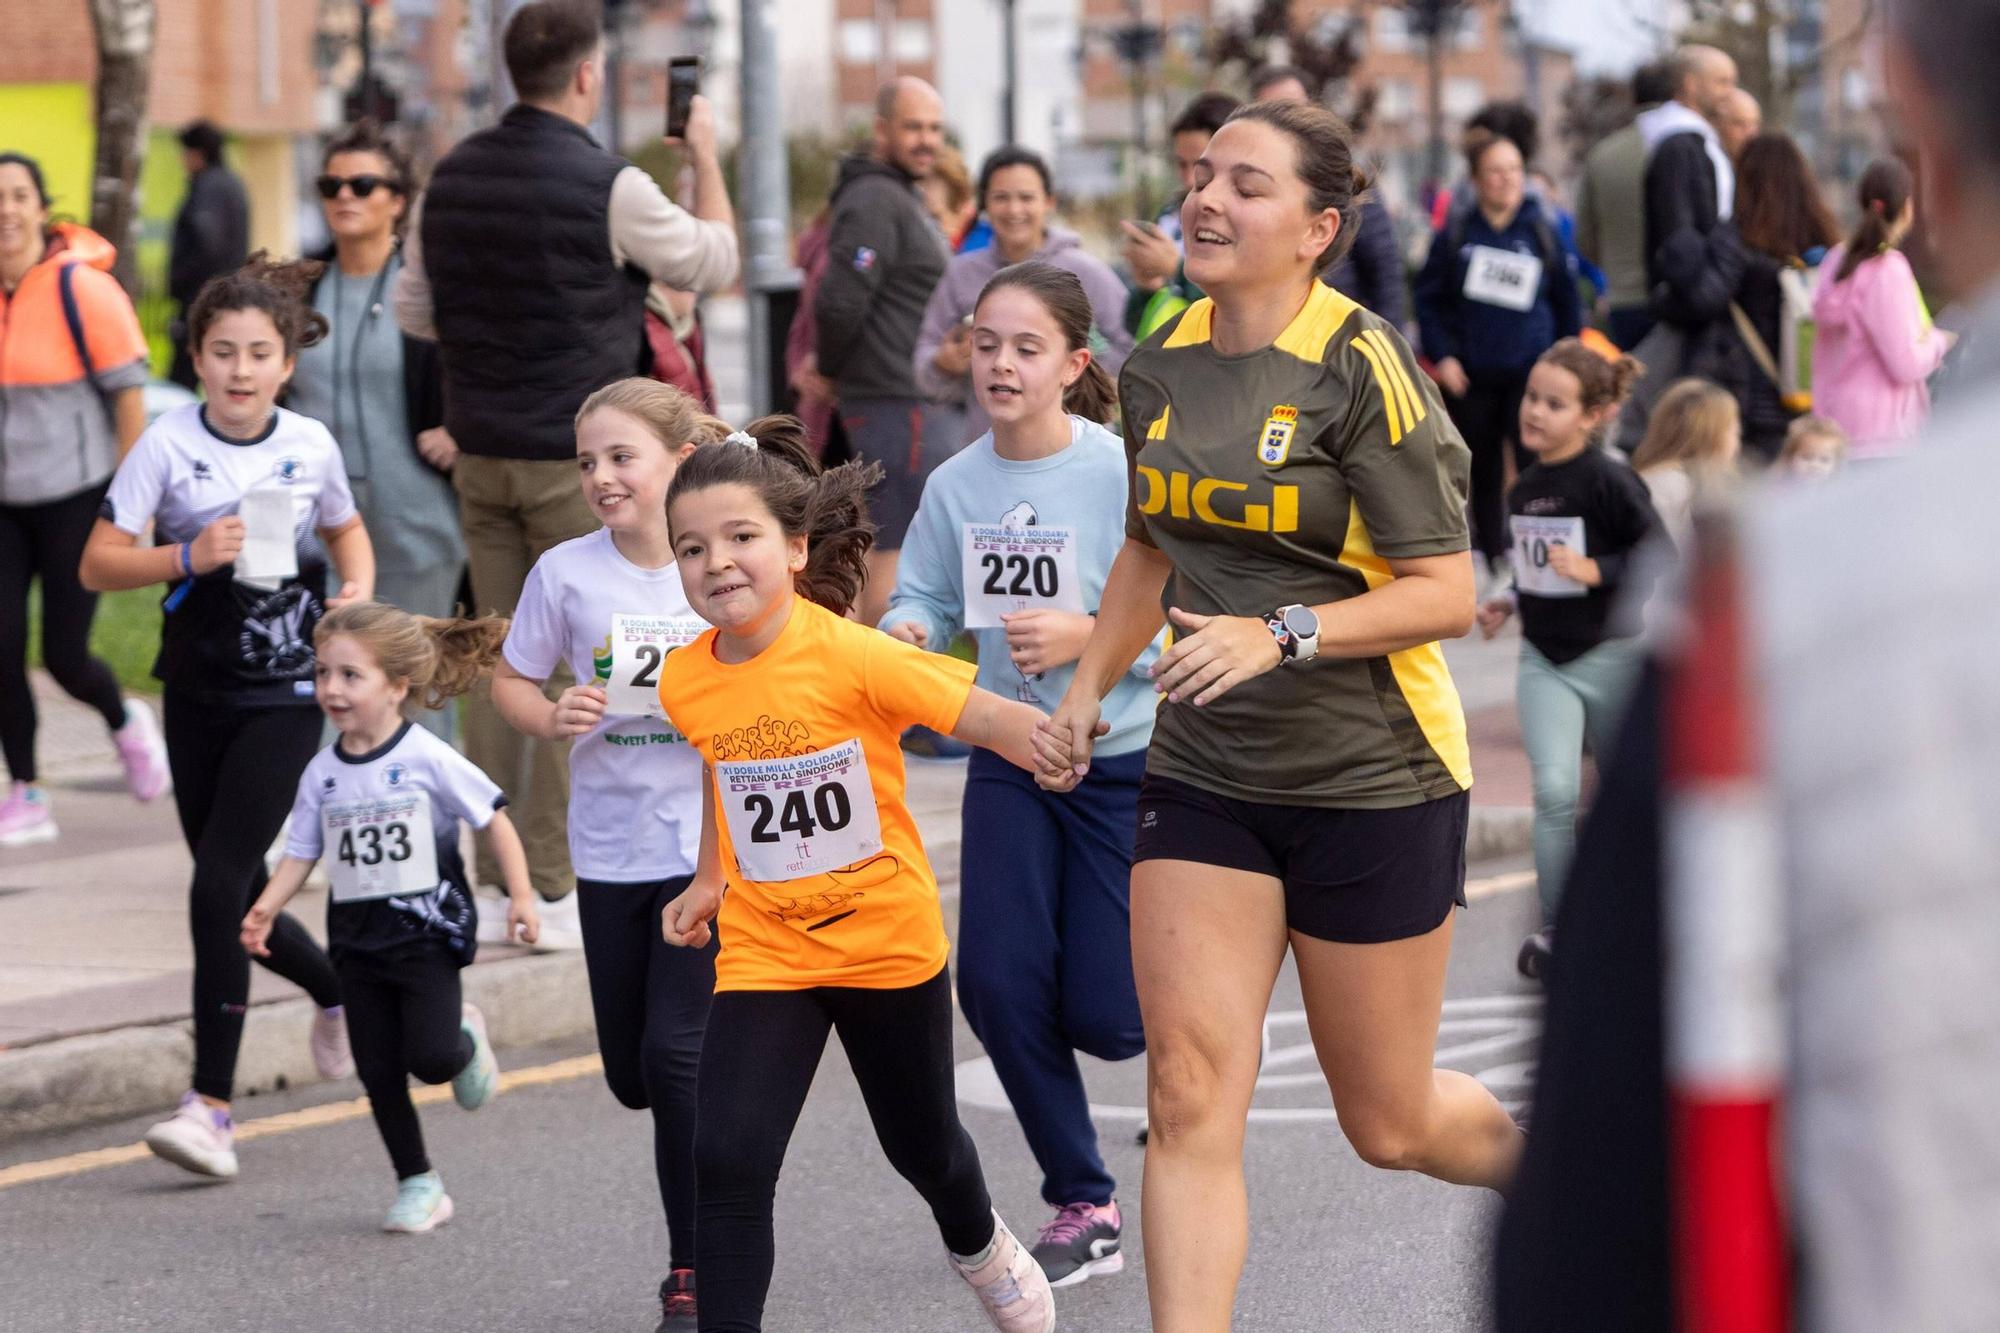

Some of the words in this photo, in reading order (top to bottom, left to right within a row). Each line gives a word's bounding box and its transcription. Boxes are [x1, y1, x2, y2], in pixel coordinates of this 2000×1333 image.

[973, 543, 1001, 551] DE
[1006, 544, 1066, 553] RETT
[974, 535, 1010, 543] RETTANDO
[1024, 537, 1065, 545] SINDROME
[1028, 530, 1070, 538] SOLIDARIA
[1522, 537, 1566, 568] 10
[981, 552, 1059, 598] 220
[625, 627, 669, 635] RETTANDO
[672, 628, 683, 636] AL
[625, 635, 657, 643] DE
[629, 644, 683, 687] 2
[649, 732, 675, 744] POR
[712, 715, 810, 760] CARRERA
[723, 767, 732, 776] XI
[734, 766, 765, 775] DOBLE
[765, 764, 796, 774] MILLA
[800, 747, 855, 770] SOLIDARIA
[729, 773, 779, 784] RETTANDO
[781, 771, 795, 781] AL
[796, 757, 851, 779] SINDROME
[730, 782, 766, 793] DE
[774, 763, 852, 791] RETT
[743, 781, 852, 843] 240
[338, 821, 412, 867] 433
